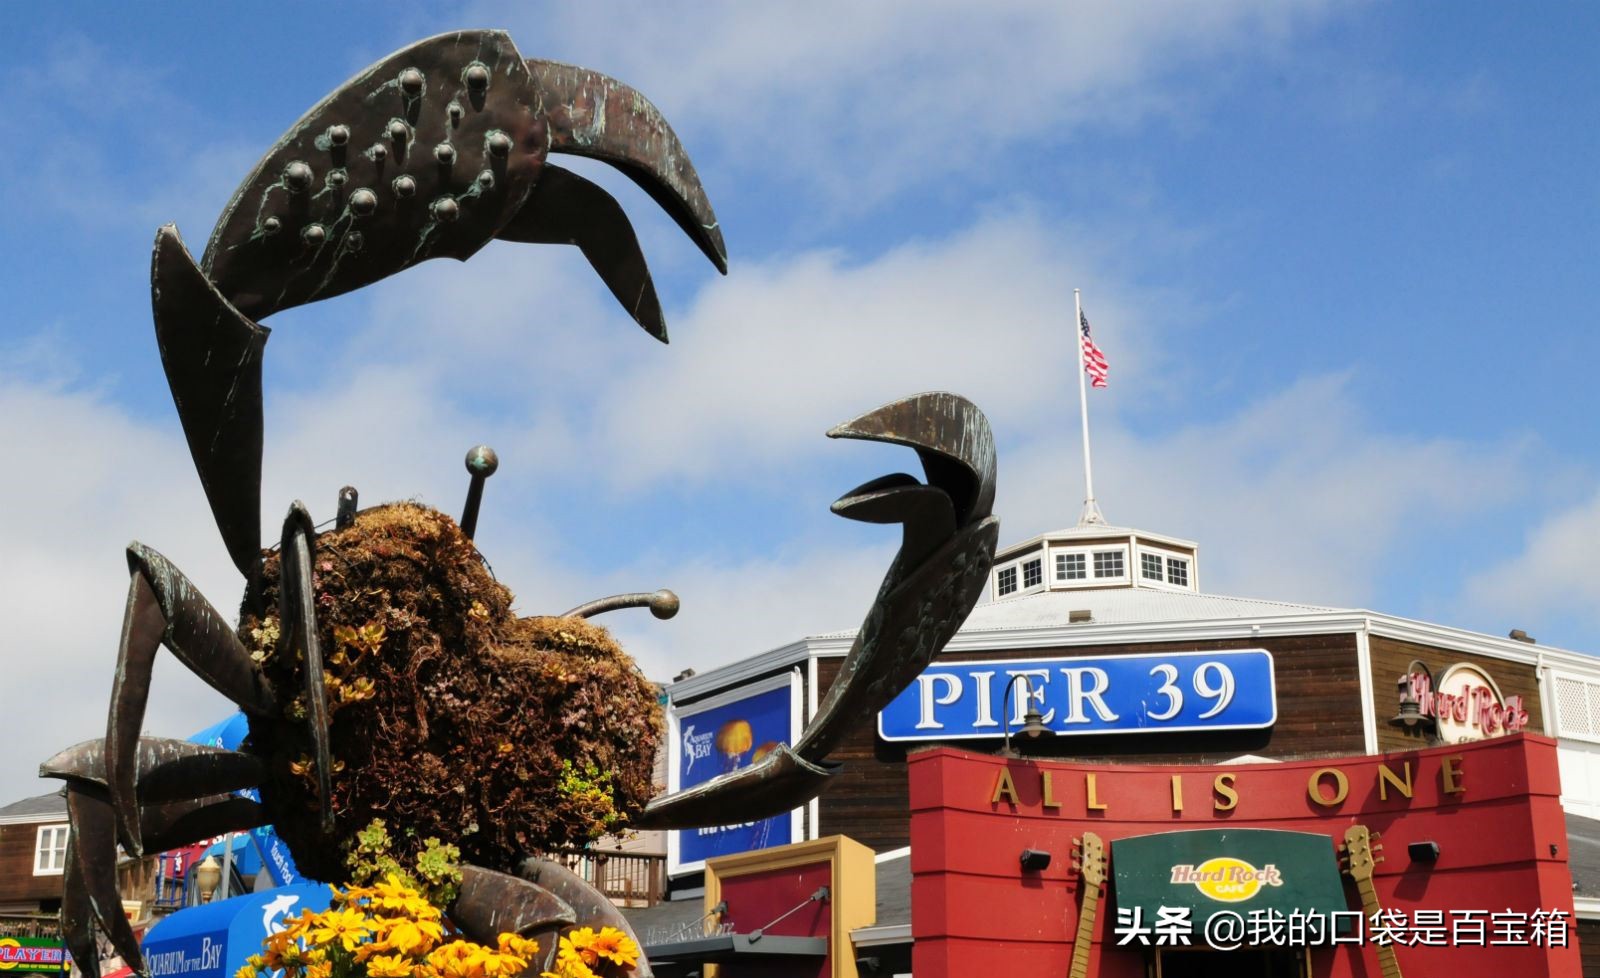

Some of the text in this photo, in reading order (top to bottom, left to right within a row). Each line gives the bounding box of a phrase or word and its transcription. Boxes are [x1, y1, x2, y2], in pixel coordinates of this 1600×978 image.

[915, 661, 1235, 729] PIER 39
[1398, 672, 1529, 736] Hard Rock
[695, 743, 712, 759] BAY
[991, 755, 1466, 811] ALL IS ONE
[270, 840, 295, 886] Touch Pool
[1170, 864, 1284, 887] Hard Rock
[142, 948, 185, 978] AQUARIUM
[201, 937, 222, 970] BAY
